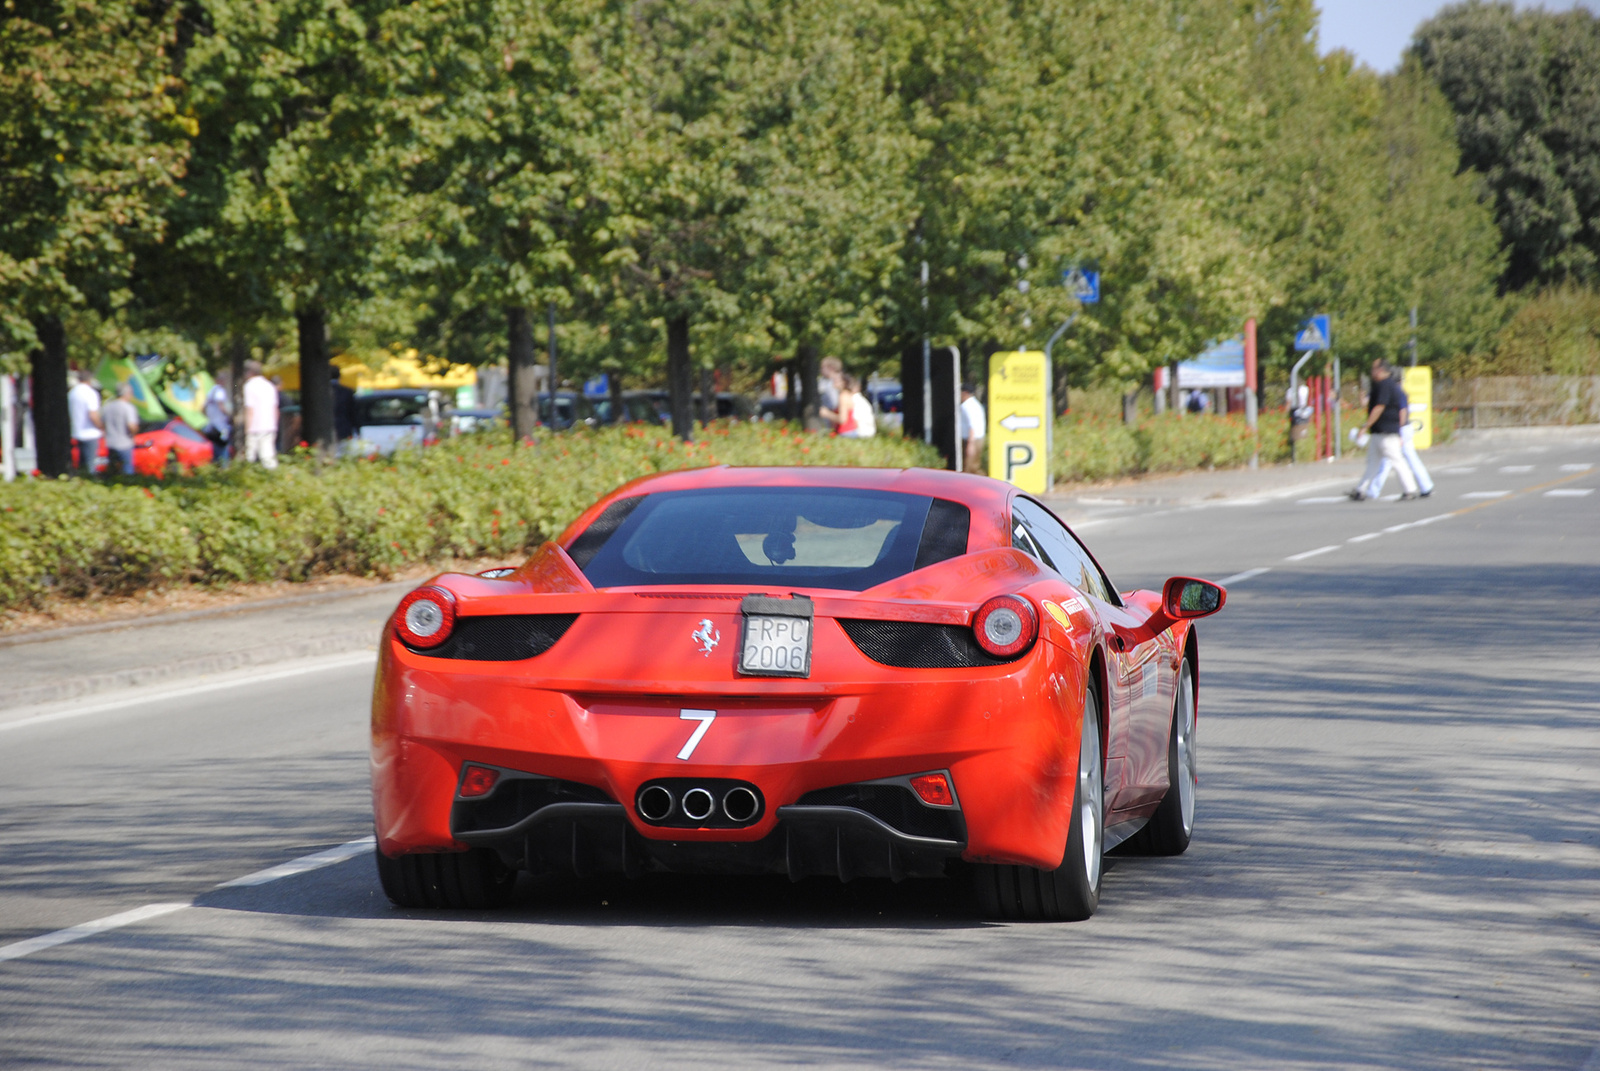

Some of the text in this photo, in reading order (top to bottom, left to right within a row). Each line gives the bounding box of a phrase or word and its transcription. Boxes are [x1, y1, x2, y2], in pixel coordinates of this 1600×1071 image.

[1005, 444, 1034, 480] P
[745, 645, 802, 669] 2006
[676, 708, 717, 761] 7
